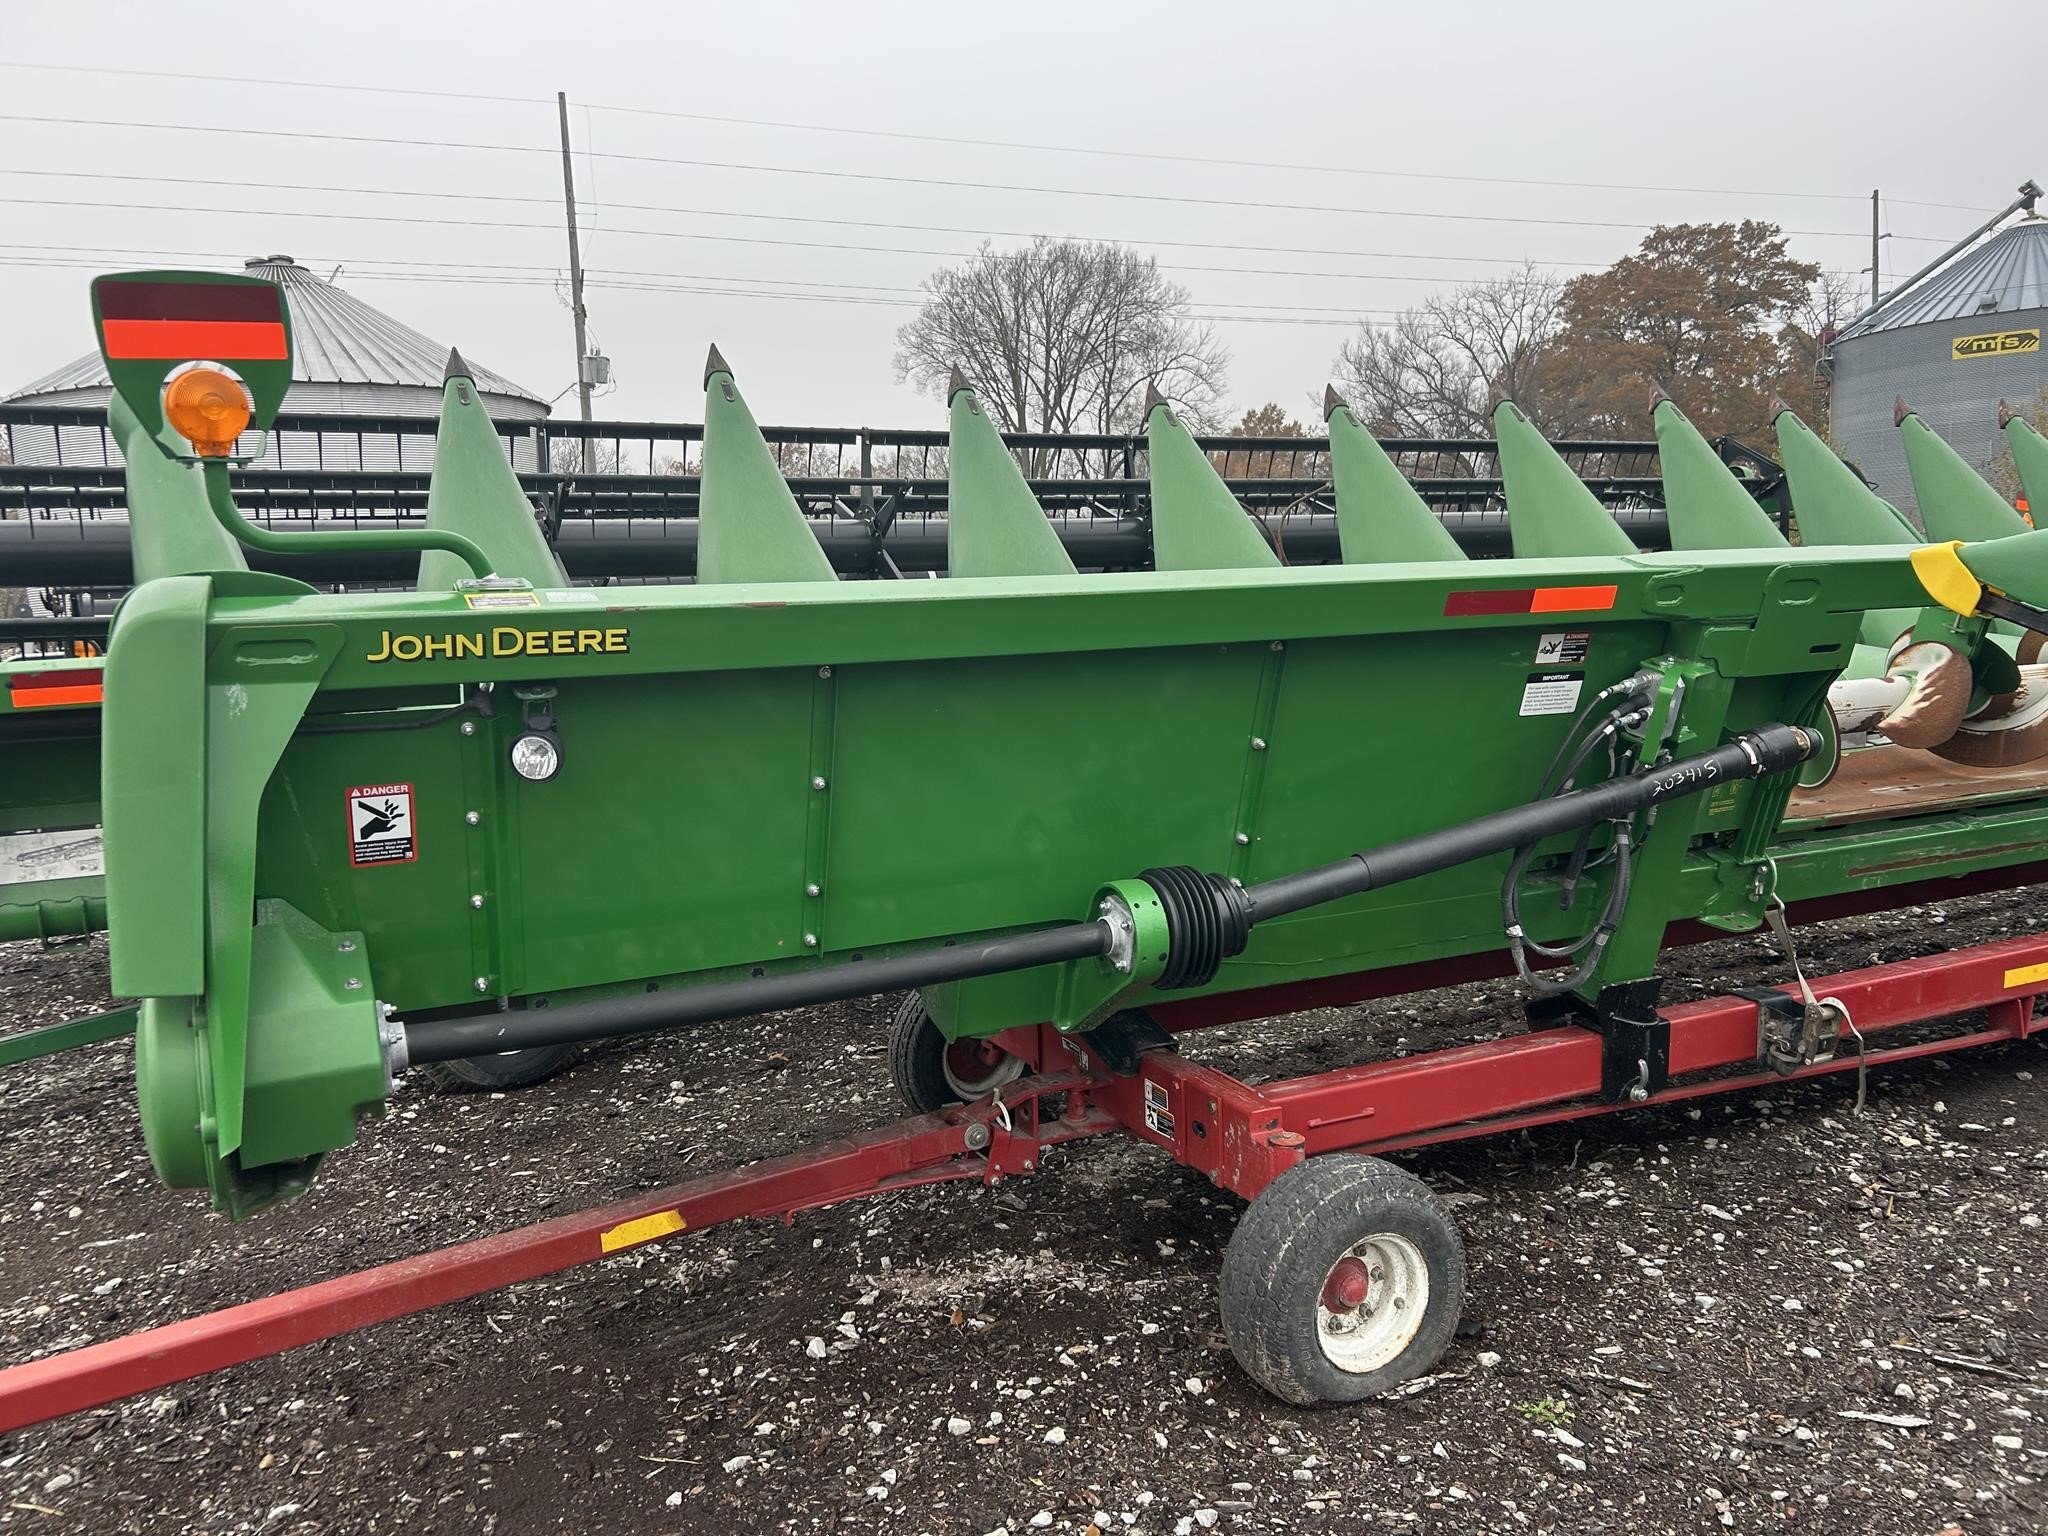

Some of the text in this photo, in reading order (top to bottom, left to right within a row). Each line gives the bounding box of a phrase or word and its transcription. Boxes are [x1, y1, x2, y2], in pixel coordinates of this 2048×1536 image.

[1972, 335, 2020, 351] mfs
[366, 627, 630, 662] JOHN DEERE
[363, 785, 409, 796] DANGER
[1652, 759, 1717, 797] 203415
